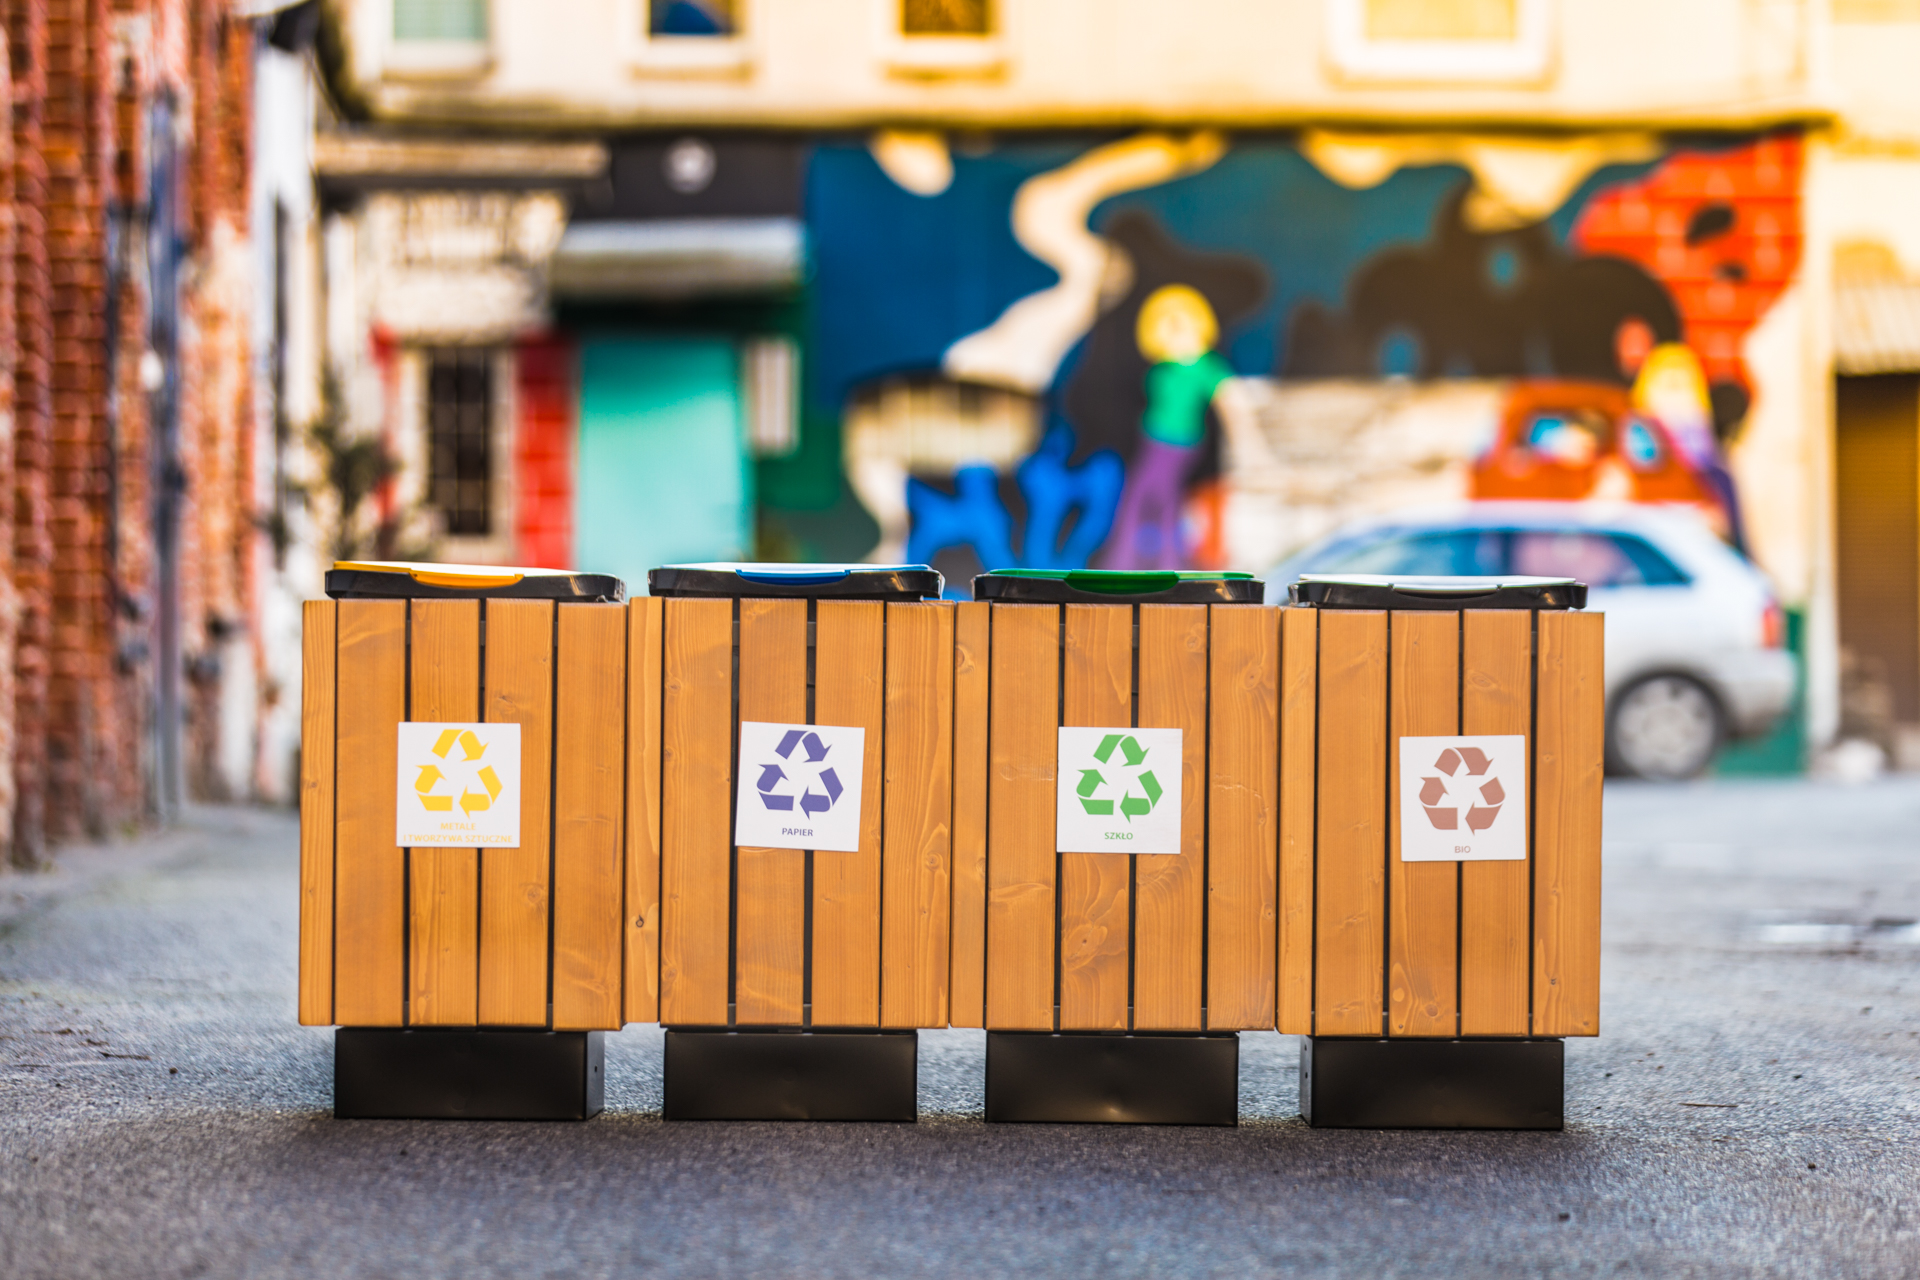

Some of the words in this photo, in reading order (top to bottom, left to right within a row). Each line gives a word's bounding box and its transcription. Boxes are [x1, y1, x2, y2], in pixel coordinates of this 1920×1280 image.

[440, 822, 476, 831] METALE
[781, 827, 814, 837] PAPIER
[1104, 832, 1134, 840] SZKŁO
[408, 834, 463, 842] TWORZYWA
[465, 834, 513, 843] SZTUCZNE
[1454, 845, 1472, 854] BIO
